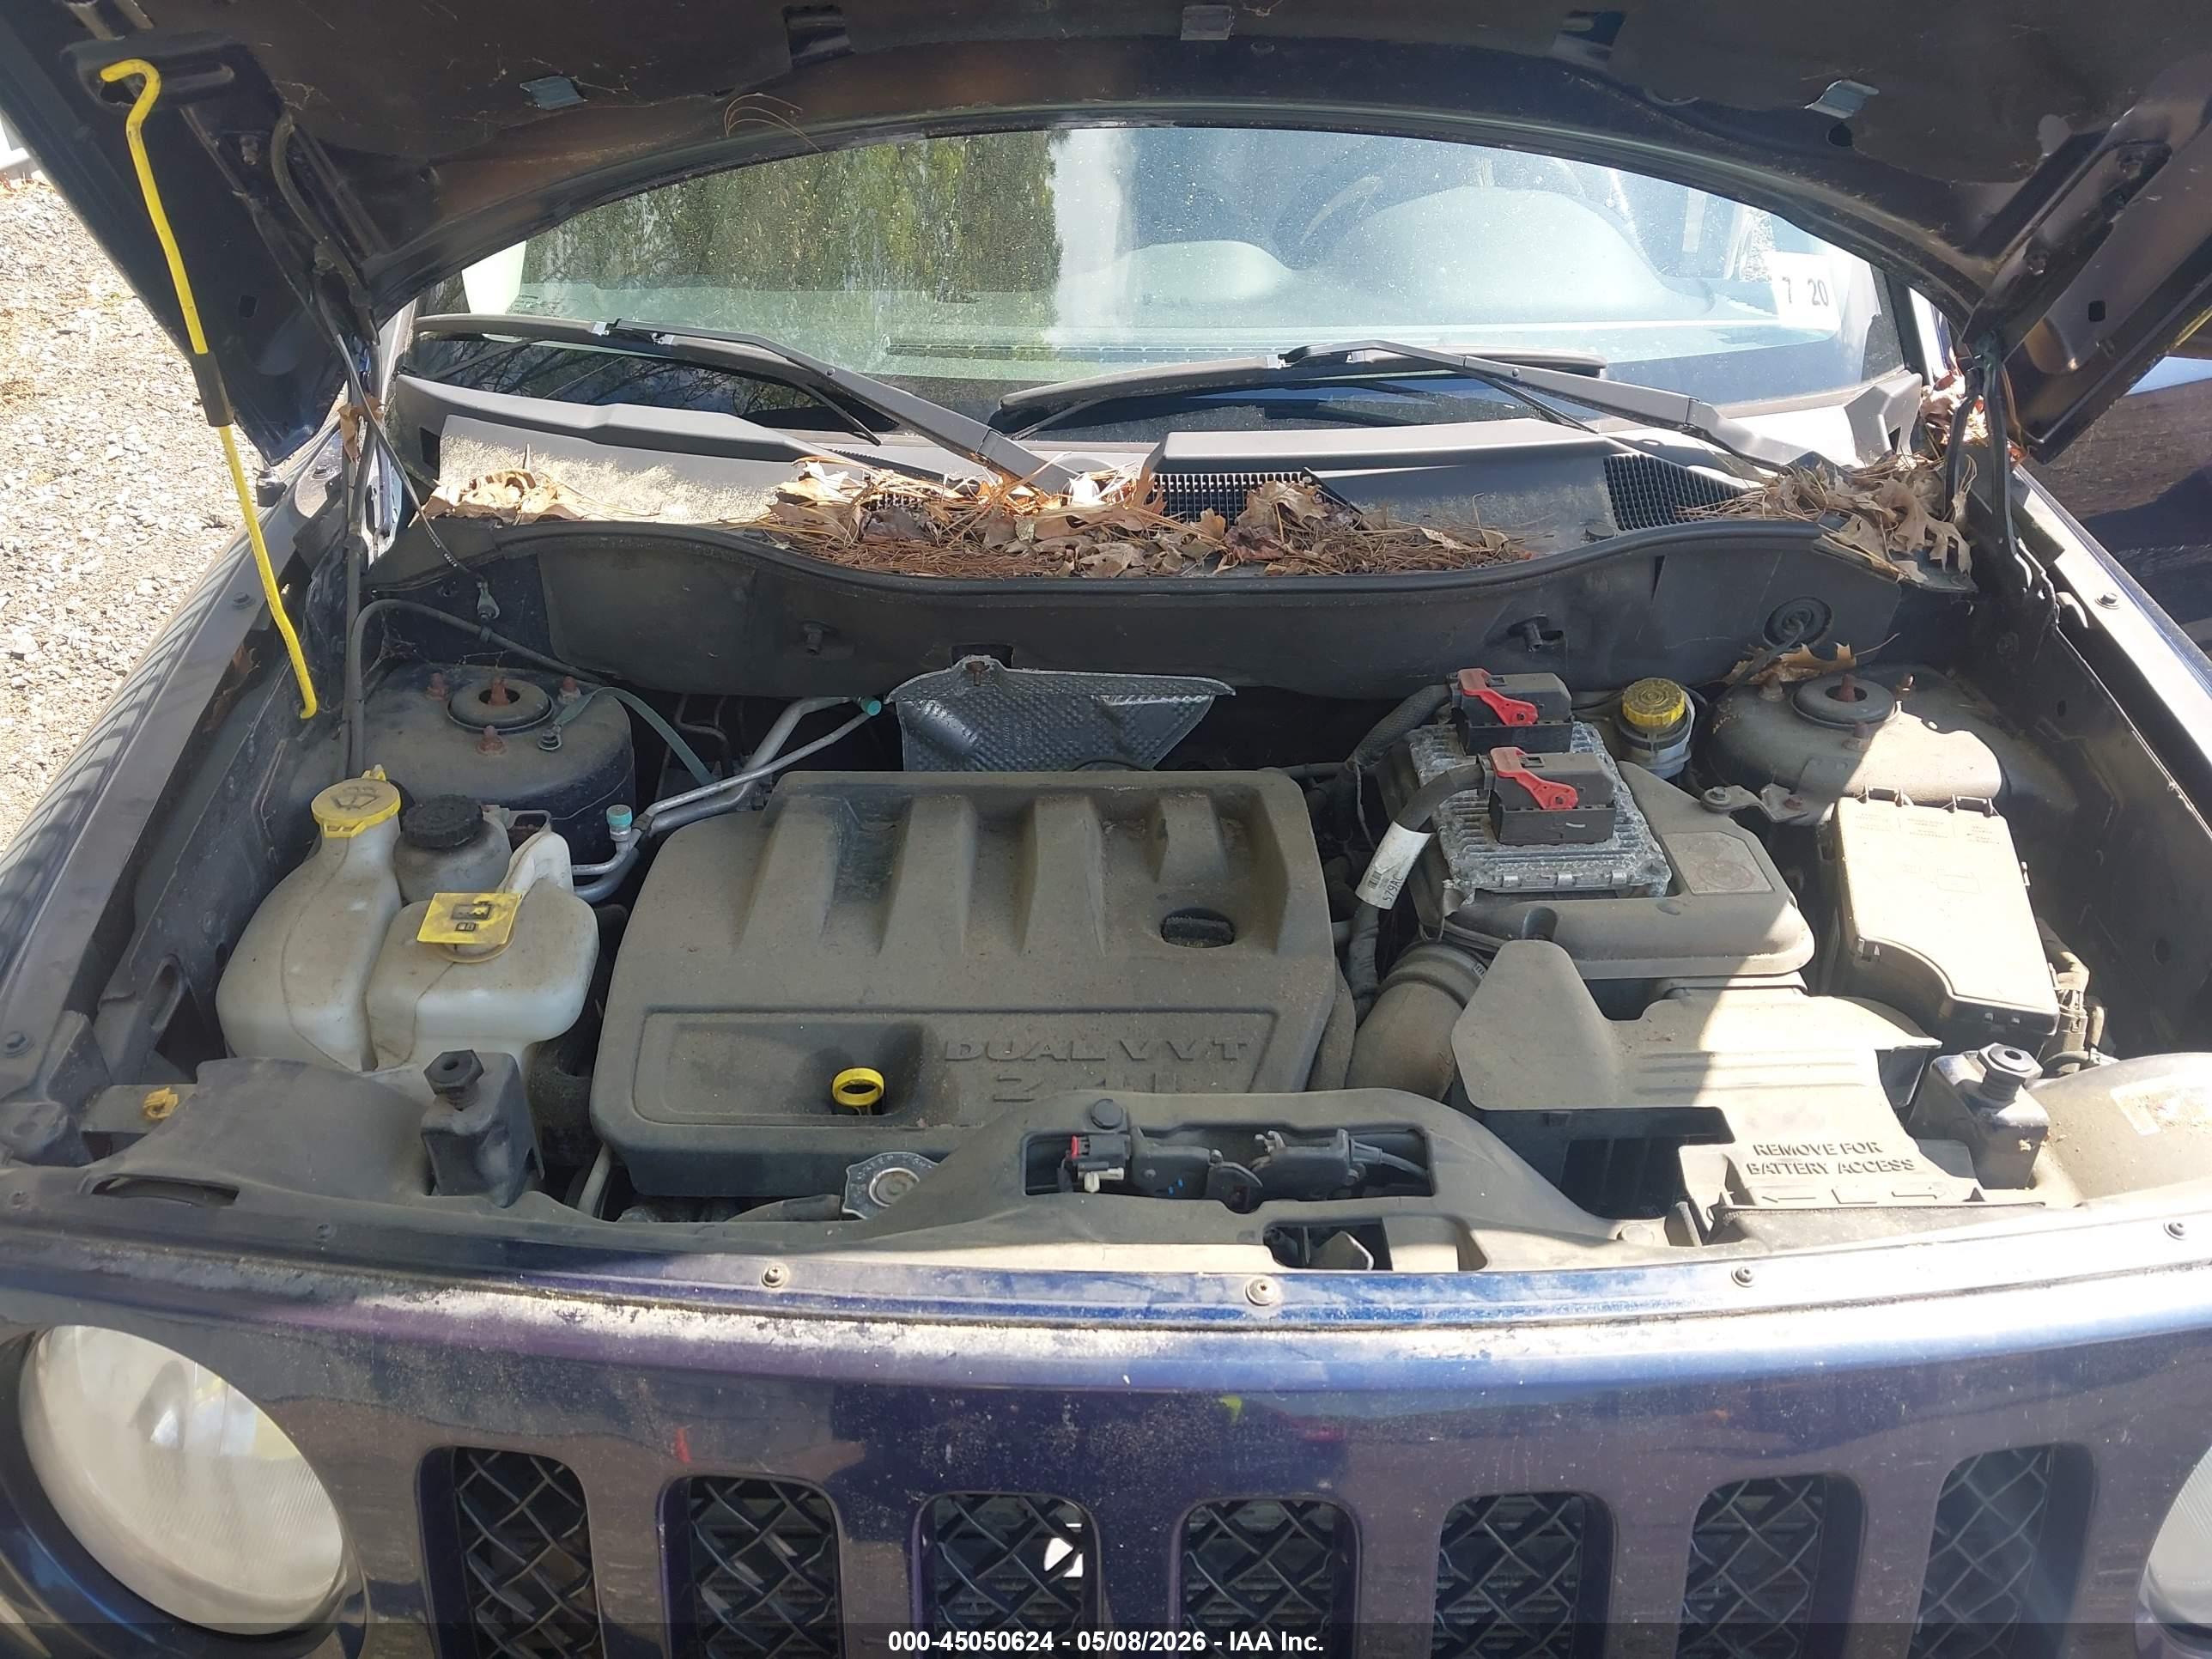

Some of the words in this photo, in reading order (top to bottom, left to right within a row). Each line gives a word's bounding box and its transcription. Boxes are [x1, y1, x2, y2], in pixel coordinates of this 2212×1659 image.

[1782, 276, 1792, 304] 7
[1808, 278, 1829, 307] 20
[945, 1039, 1107, 1062] DUAL
[1118, 1038, 1249, 1062] VVT
[1753, 1143, 1838, 1157] REMOVE
[1839, 1141, 1884, 1155] FOR
[1746, 1162, 1831, 1175] BATTERY
[1838, 1159, 1916, 1175] ACCESS
